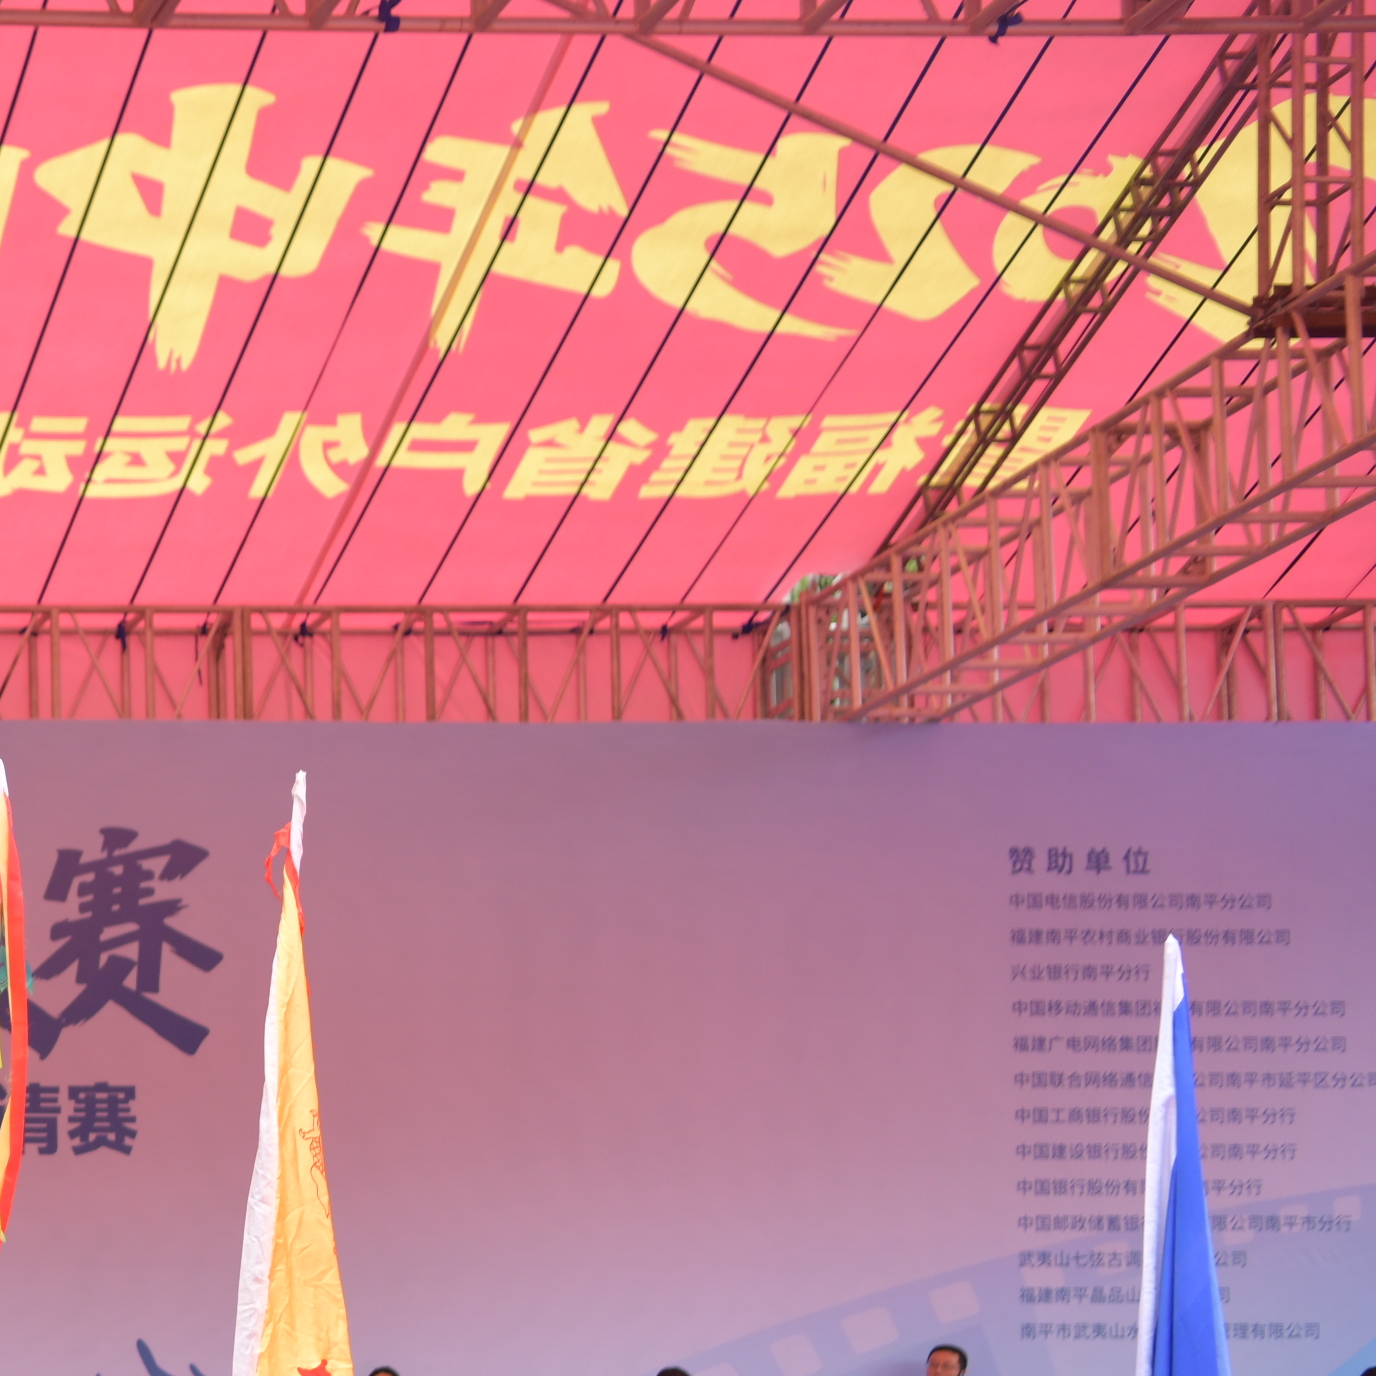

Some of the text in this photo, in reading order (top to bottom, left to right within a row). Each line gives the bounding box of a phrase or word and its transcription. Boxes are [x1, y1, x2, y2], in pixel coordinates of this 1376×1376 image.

[1008, 846, 1151, 875] 赞助单位
[1009, 892, 1273, 910] 中国电信股份有限公司南平分公司
[1011, 963, 1151, 982] 兴业银行南平分行
[1012, 999, 1346, 1018] 中国移动通信集团有限公司南平分公司
[1013, 1035, 1347, 1053] 福建广电网络集团有限公司南平分公司
